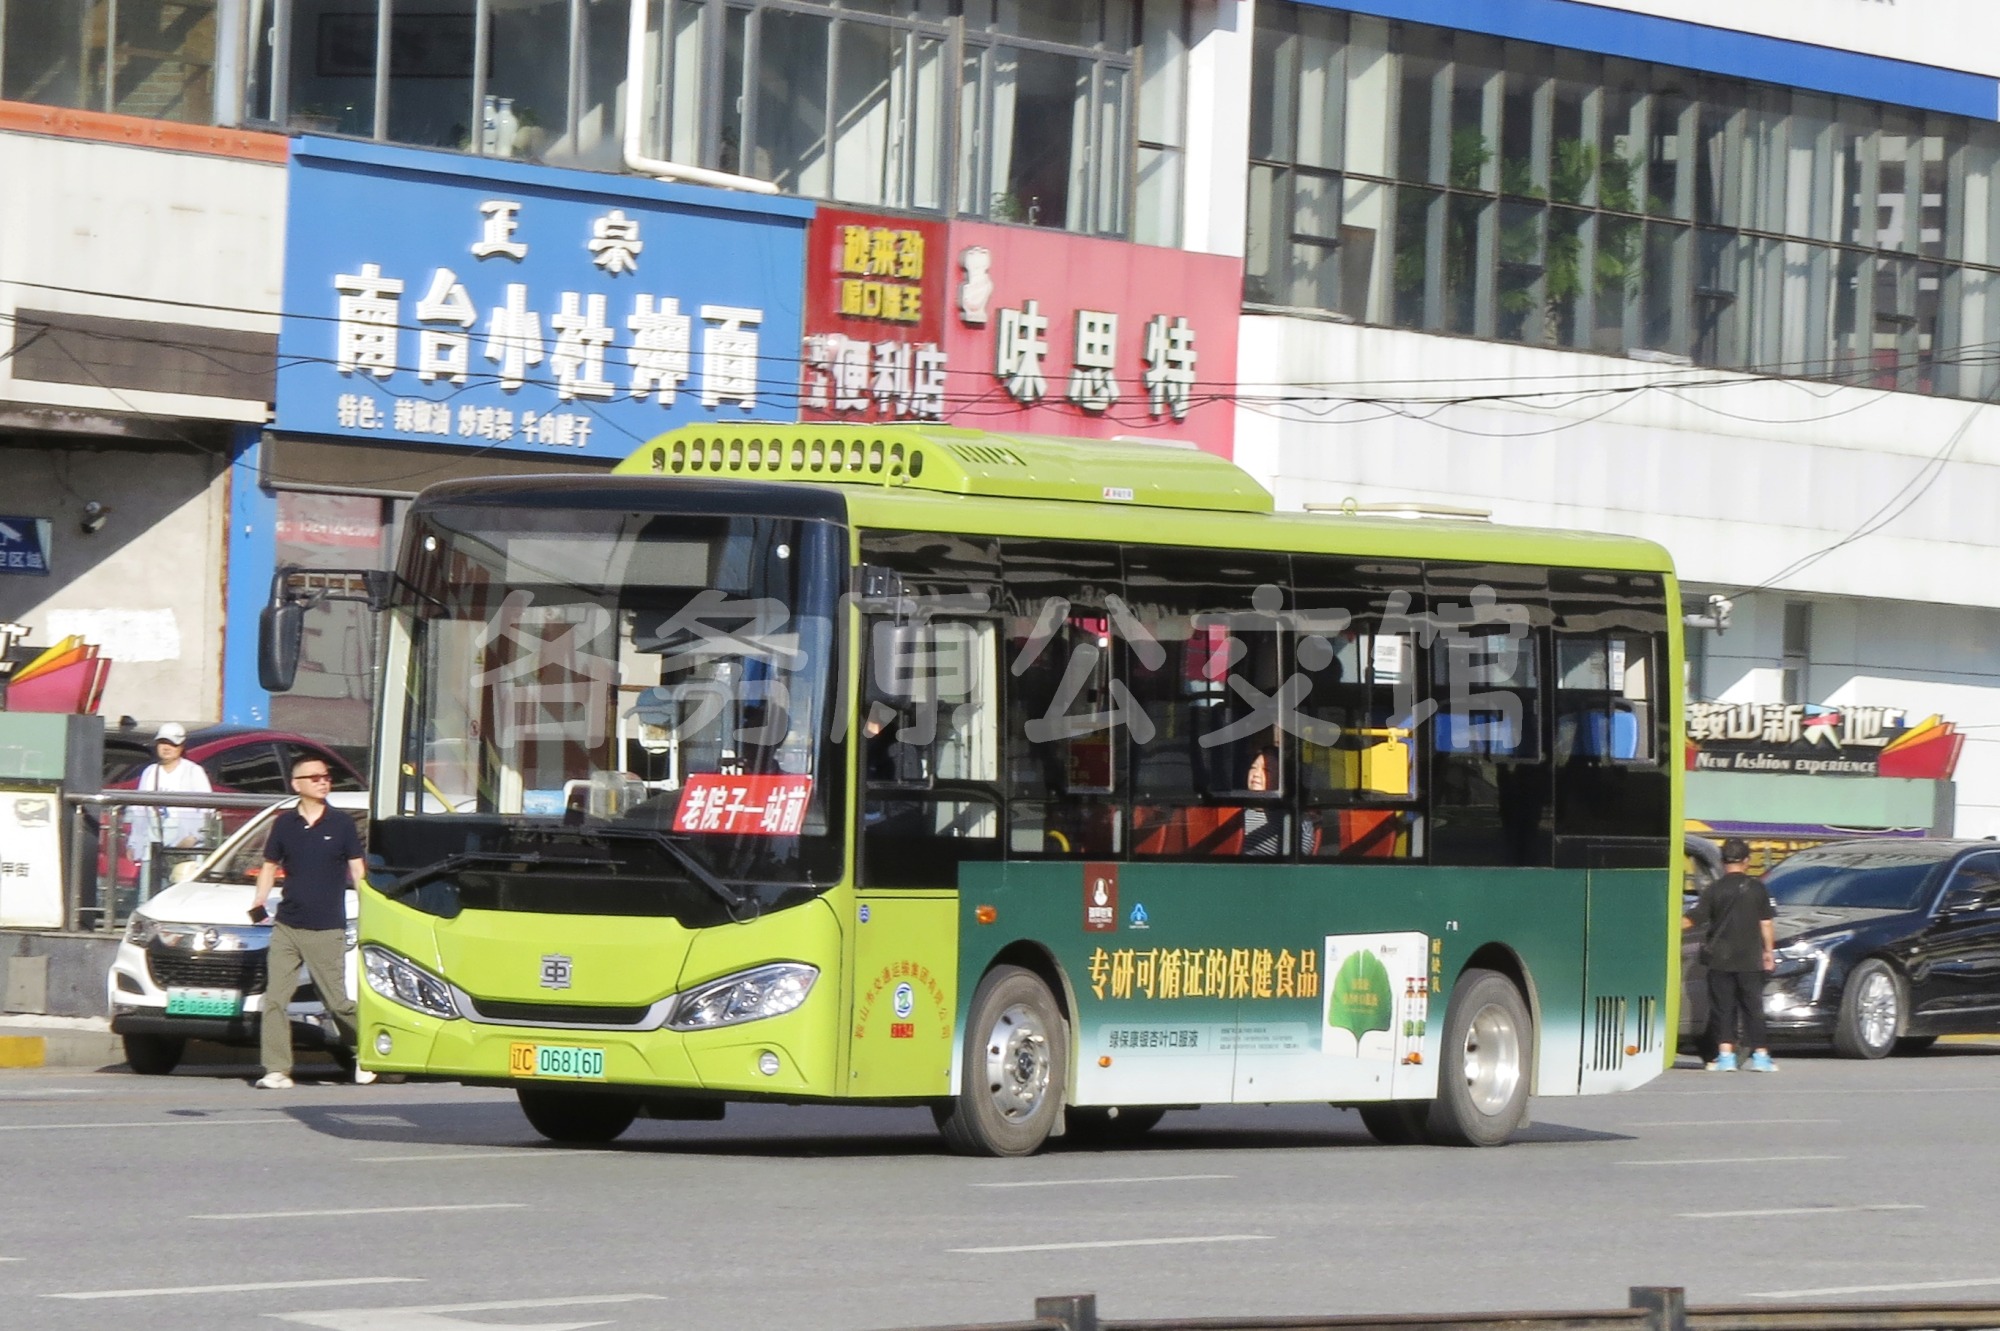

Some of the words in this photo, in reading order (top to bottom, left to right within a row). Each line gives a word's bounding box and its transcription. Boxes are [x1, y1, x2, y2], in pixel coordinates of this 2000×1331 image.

[470, 199, 644, 275] 正宗
[995, 299, 1198, 421] 味思特
[1087, 946, 1319, 1001] 专研可循证的保健食品
